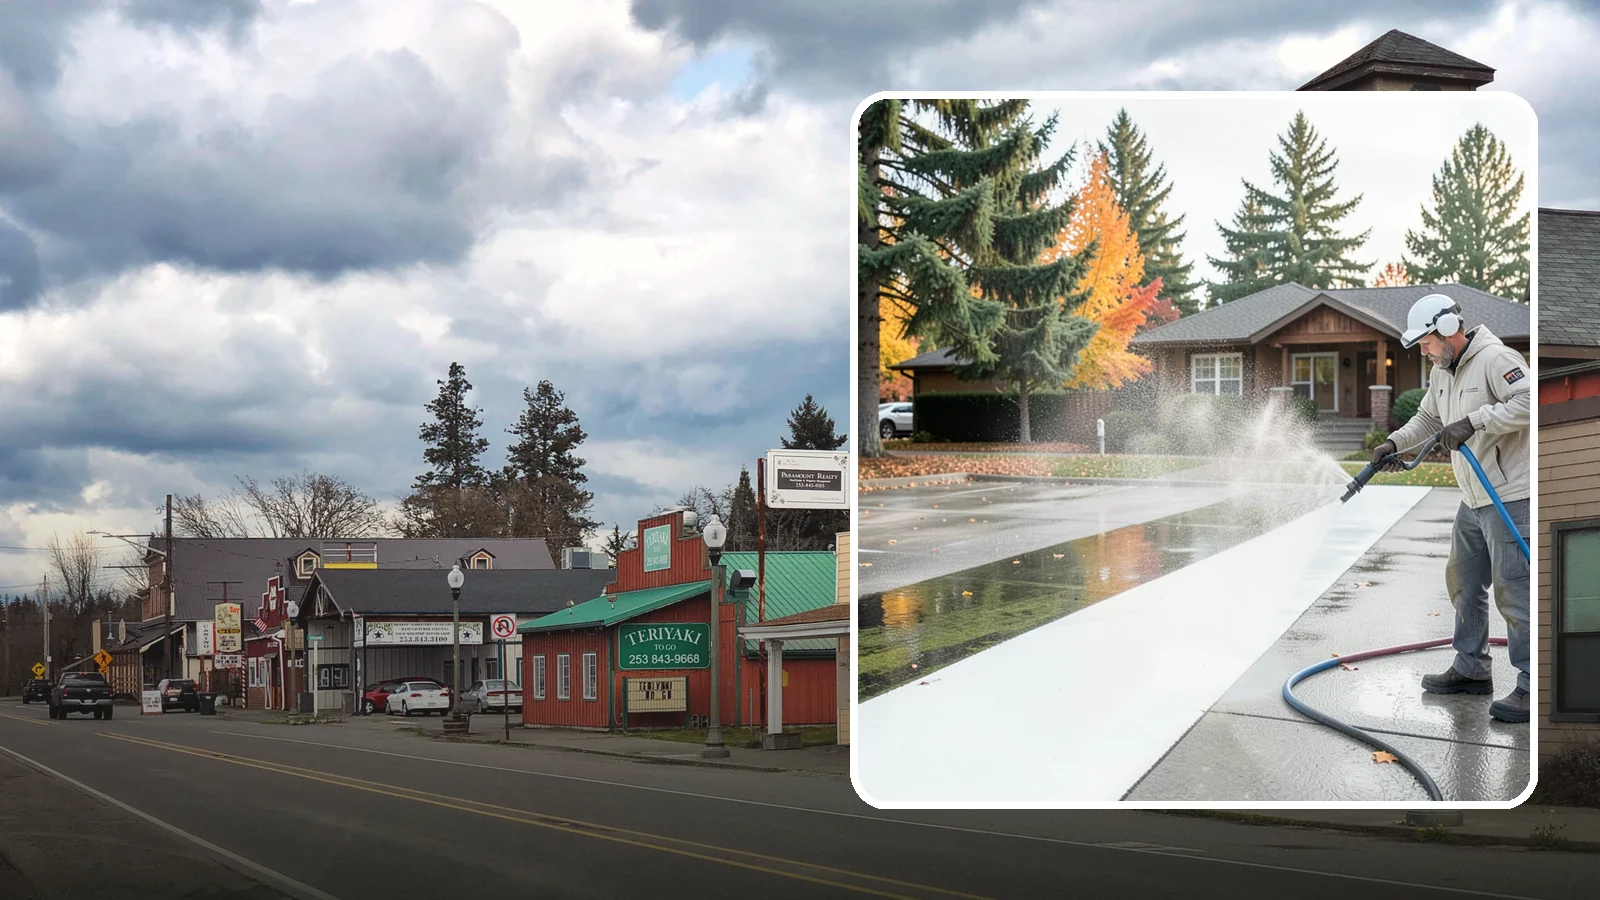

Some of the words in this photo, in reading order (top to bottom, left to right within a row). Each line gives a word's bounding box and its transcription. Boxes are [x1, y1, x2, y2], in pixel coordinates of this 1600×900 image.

[781, 471, 815, 479] PARAMOUNT
[817, 472, 839, 480] REALTY
[624, 627, 702, 646] TERIYAKI
[653, 643, 665, 651] TO
[665, 643, 677, 651] GO
[628, 654, 649, 665] 253
[651, 653, 700, 664] 843-9668
